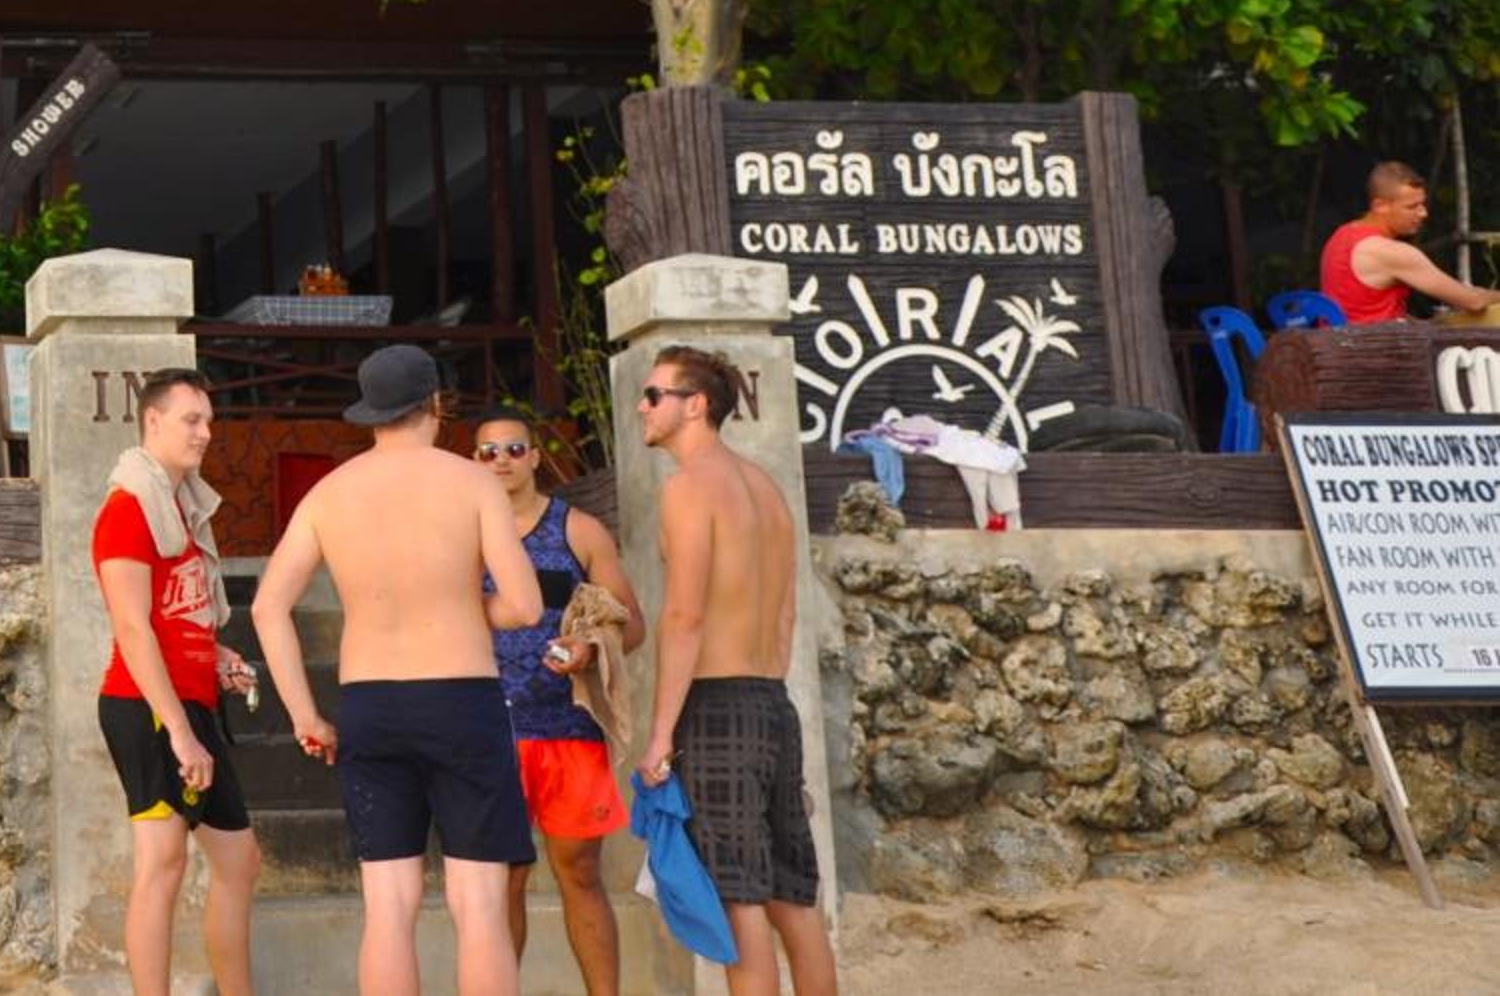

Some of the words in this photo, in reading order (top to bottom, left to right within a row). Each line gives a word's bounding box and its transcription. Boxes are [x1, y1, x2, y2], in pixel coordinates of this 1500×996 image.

[12, 79, 84, 156] SHOWER
[736, 131, 873, 195] คอรัล
[894, 132, 1077, 197] บังกะโล
[741, 224, 858, 253] CORAL
[877, 224, 1082, 254] BUNGALOWS
[1303, 434, 1364, 466] CORAL
[1363, 434, 1476, 466] BUNGALOWS
[1316, 480, 1378, 502] HOT
[1408, 511, 1470, 535] ROOM
[1336, 546, 1375, 570] FAN
[1379, 545, 1439, 570] ROOM
[1440, 544, 1497, 569] WITH
[1347, 580, 1387, 595] ANY
[1393, 579, 1455, 595] ROOM
[1460, 579, 1498, 595] FOR
[1362, 612, 1398, 629] GET
[1403, 611, 1424, 629] IT
[1429, 611, 1497, 629] WHILE
[1366, 642, 1445, 669] STARTS
